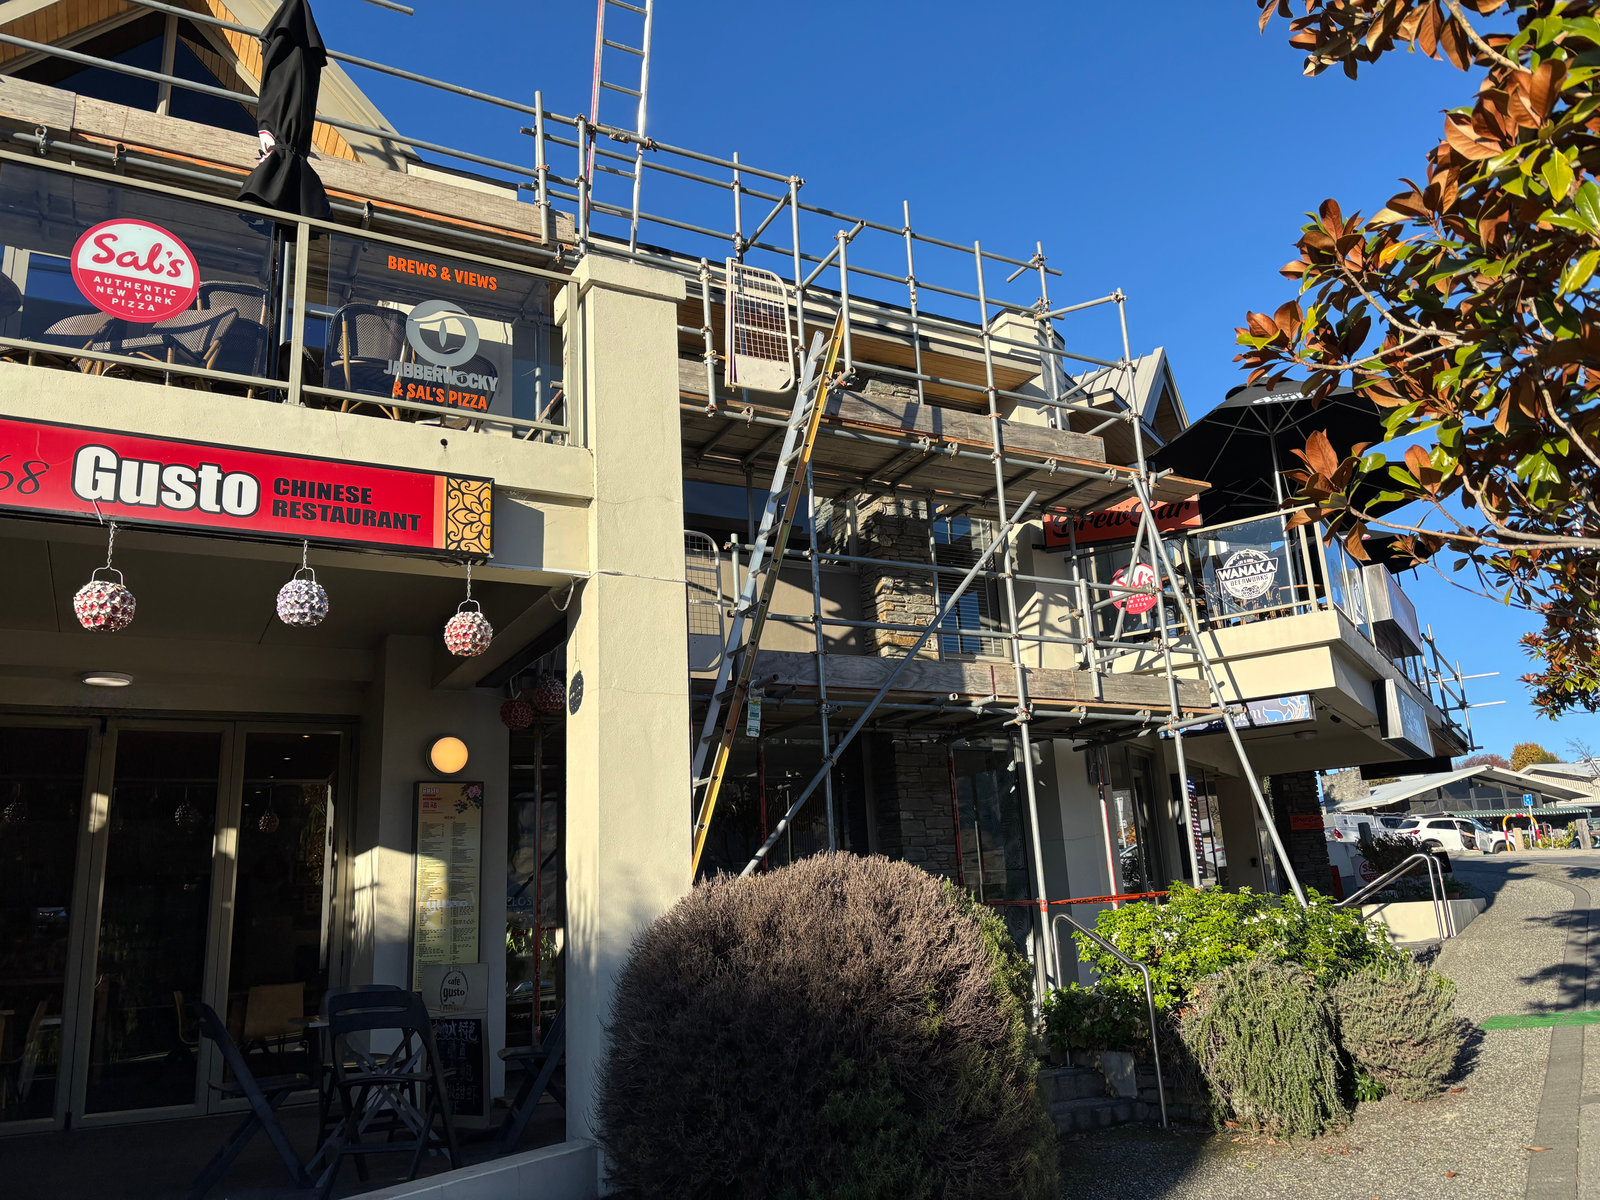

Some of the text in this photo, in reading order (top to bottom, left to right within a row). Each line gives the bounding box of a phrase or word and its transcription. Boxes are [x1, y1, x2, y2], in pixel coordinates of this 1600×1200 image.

[92, 233, 185, 278] Sal's
[93, 275, 177, 297] AUTHENTIC
[388, 255, 498, 291] BREWS & VIEWS
[96, 285, 172, 305] NEW YORK
[111, 297, 155, 312] PIZZA
[383, 359, 499, 392] JABBERWOCKY
[392, 381, 488, 411] & SAL'S PIZZA
[72, 443, 260, 518] Gusto
[273, 477, 372, 505] CHINESE
[271, 499, 421, 532] RESTAURANT
[1218, 560, 1277, 581] WANAKA
[443, 987, 465, 1002] gusto
